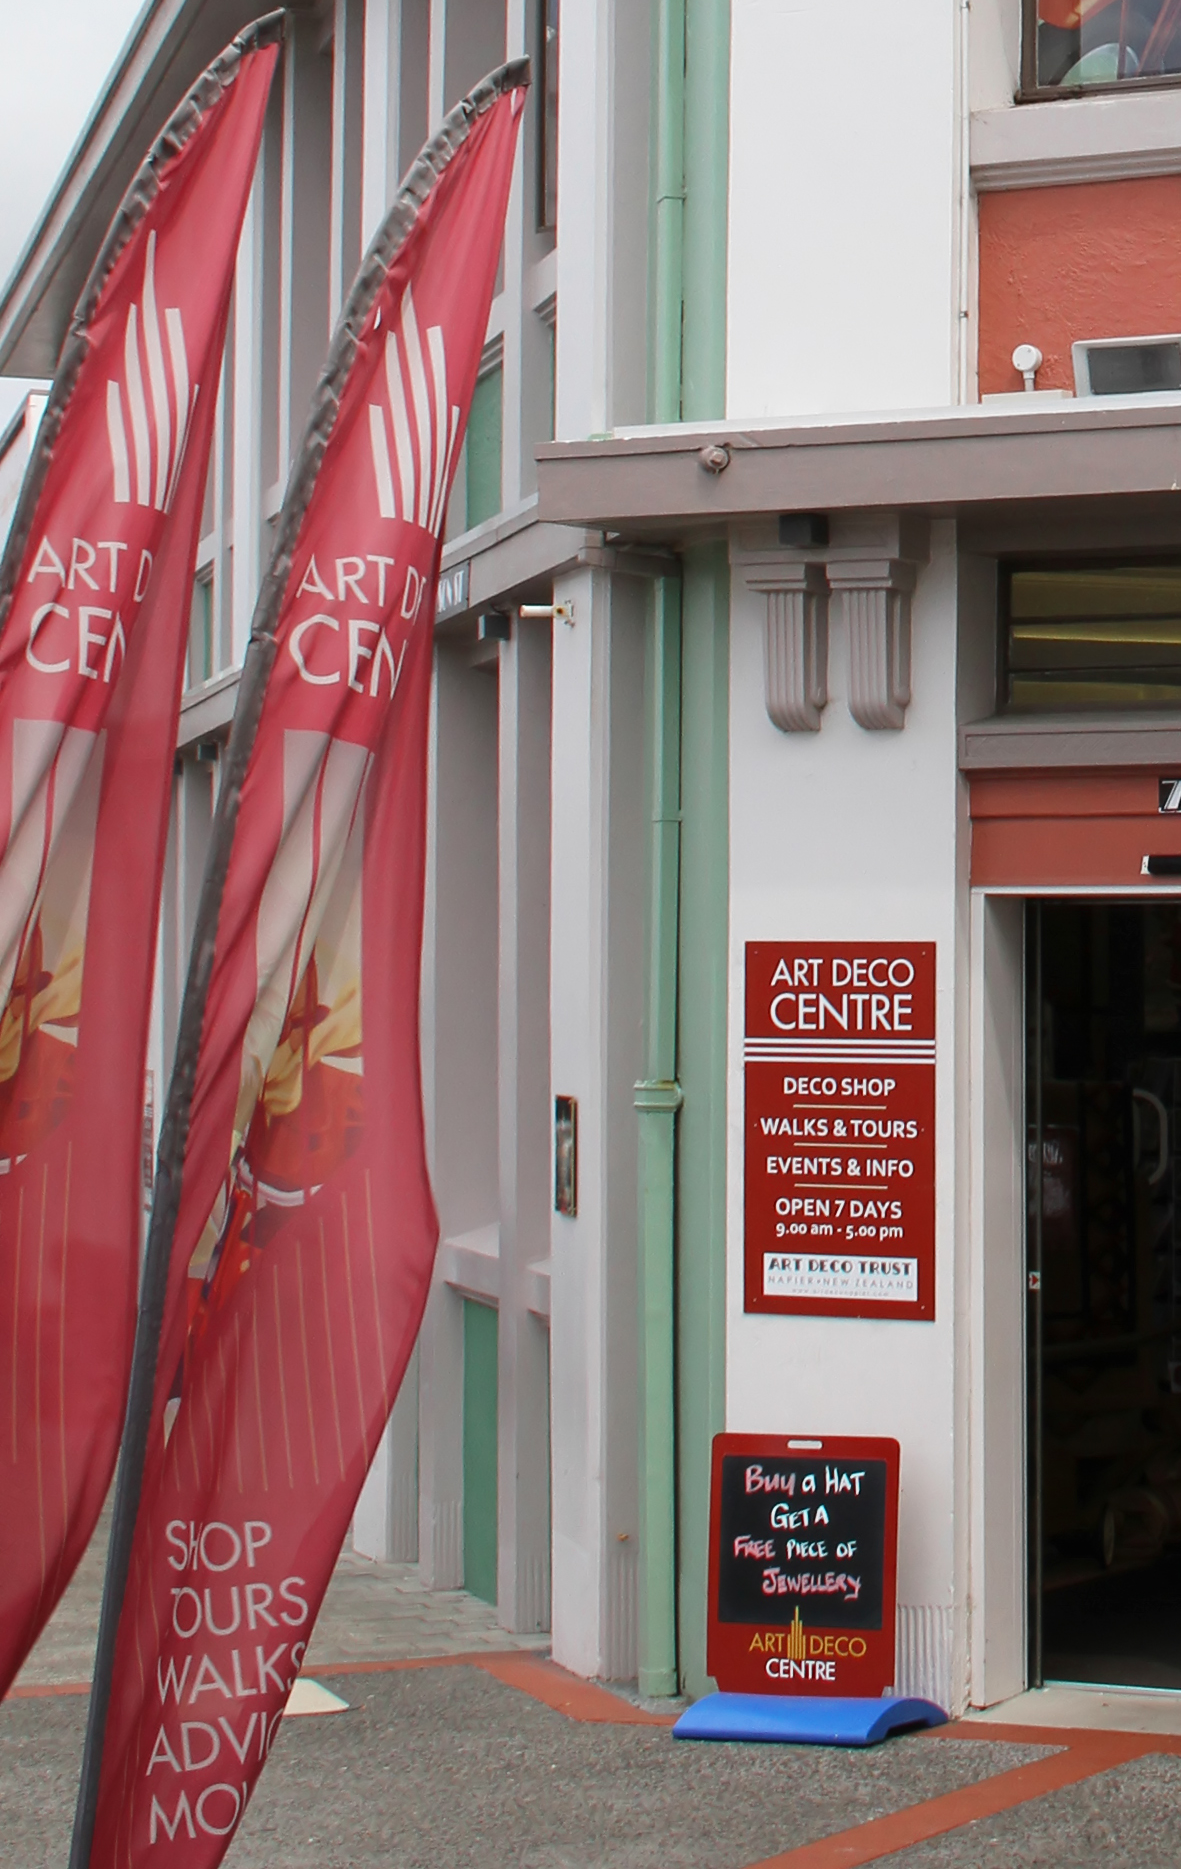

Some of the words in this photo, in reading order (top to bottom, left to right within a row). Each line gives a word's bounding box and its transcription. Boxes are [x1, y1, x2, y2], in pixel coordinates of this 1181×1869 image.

[27, 535, 128, 592] ART
[296, 554, 394, 607] ART
[770, 958, 823, 987] ART
[832, 959, 915, 988] DECO
[769, 992, 913, 1032] CENTRE
[783, 1077, 837, 1097] DECO
[841, 1077, 896, 1097] SHOP
[760, 1118, 829, 1137] WALKS
[833, 1119, 848, 1137] &
[850, 1119, 918, 1139] TOURS
[766, 1157, 843, 1176] EVENTS
[847, 1157, 862, 1177] &
[866, 1159, 914, 1178] INFO
[775, 1197, 832, 1217] OPEN
[834, 1199, 845, 1218] 7
[849, 1200, 902, 1219] DAYS
[775, 1222, 808, 1238] 9.00
[810, 1224, 833, 1237] am
[845, 1225, 877, 1240] 5.00
[879, 1226, 904, 1242] pm
[768, 1258, 803, 1271] ART
[808, 1259, 854, 1273] DECO
[858, 1260, 911, 1275] TRUST
[855, 1279, 913, 1289] ZEALAND
[814, 1504, 830, 1526] A
[166, 1519, 272, 1572] SHOP
[734, 1535, 776, 1559] FREE
[786, 1538, 828, 1559] PIECE
[836, 1539, 857, 1558] OF
[749, 1632, 784, 1653] ART
[810, 1635, 867, 1658] DECO
[765, 1658, 836, 1681] CENTRE
